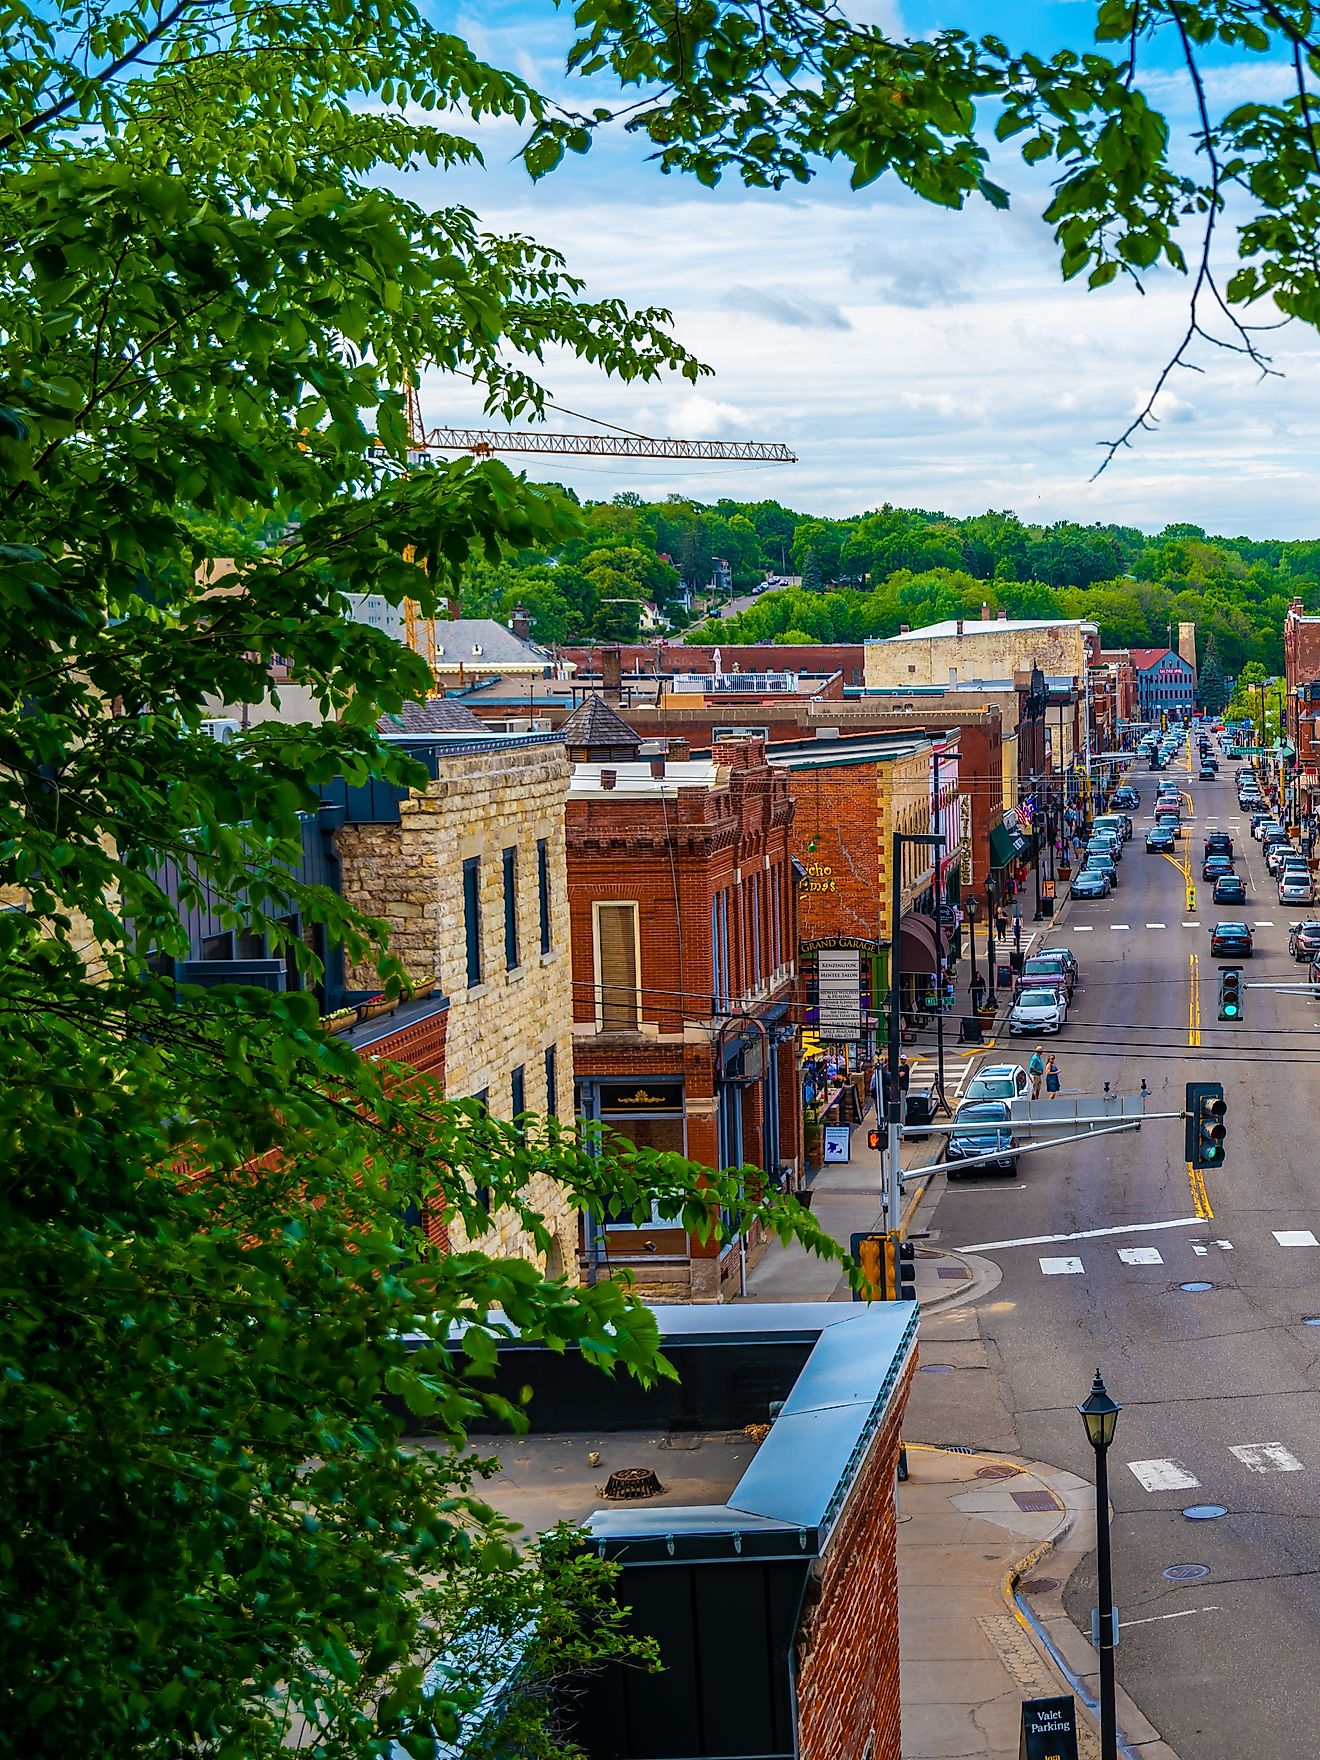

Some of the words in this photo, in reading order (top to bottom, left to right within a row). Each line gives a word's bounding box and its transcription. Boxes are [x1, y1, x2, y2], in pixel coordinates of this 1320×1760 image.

[801, 939, 836, 952] GRAND
[838, 938, 877, 953] GARAGE
[1037, 1710, 1062, 1720] Valet
[1031, 1721, 1070, 1733] Parking
